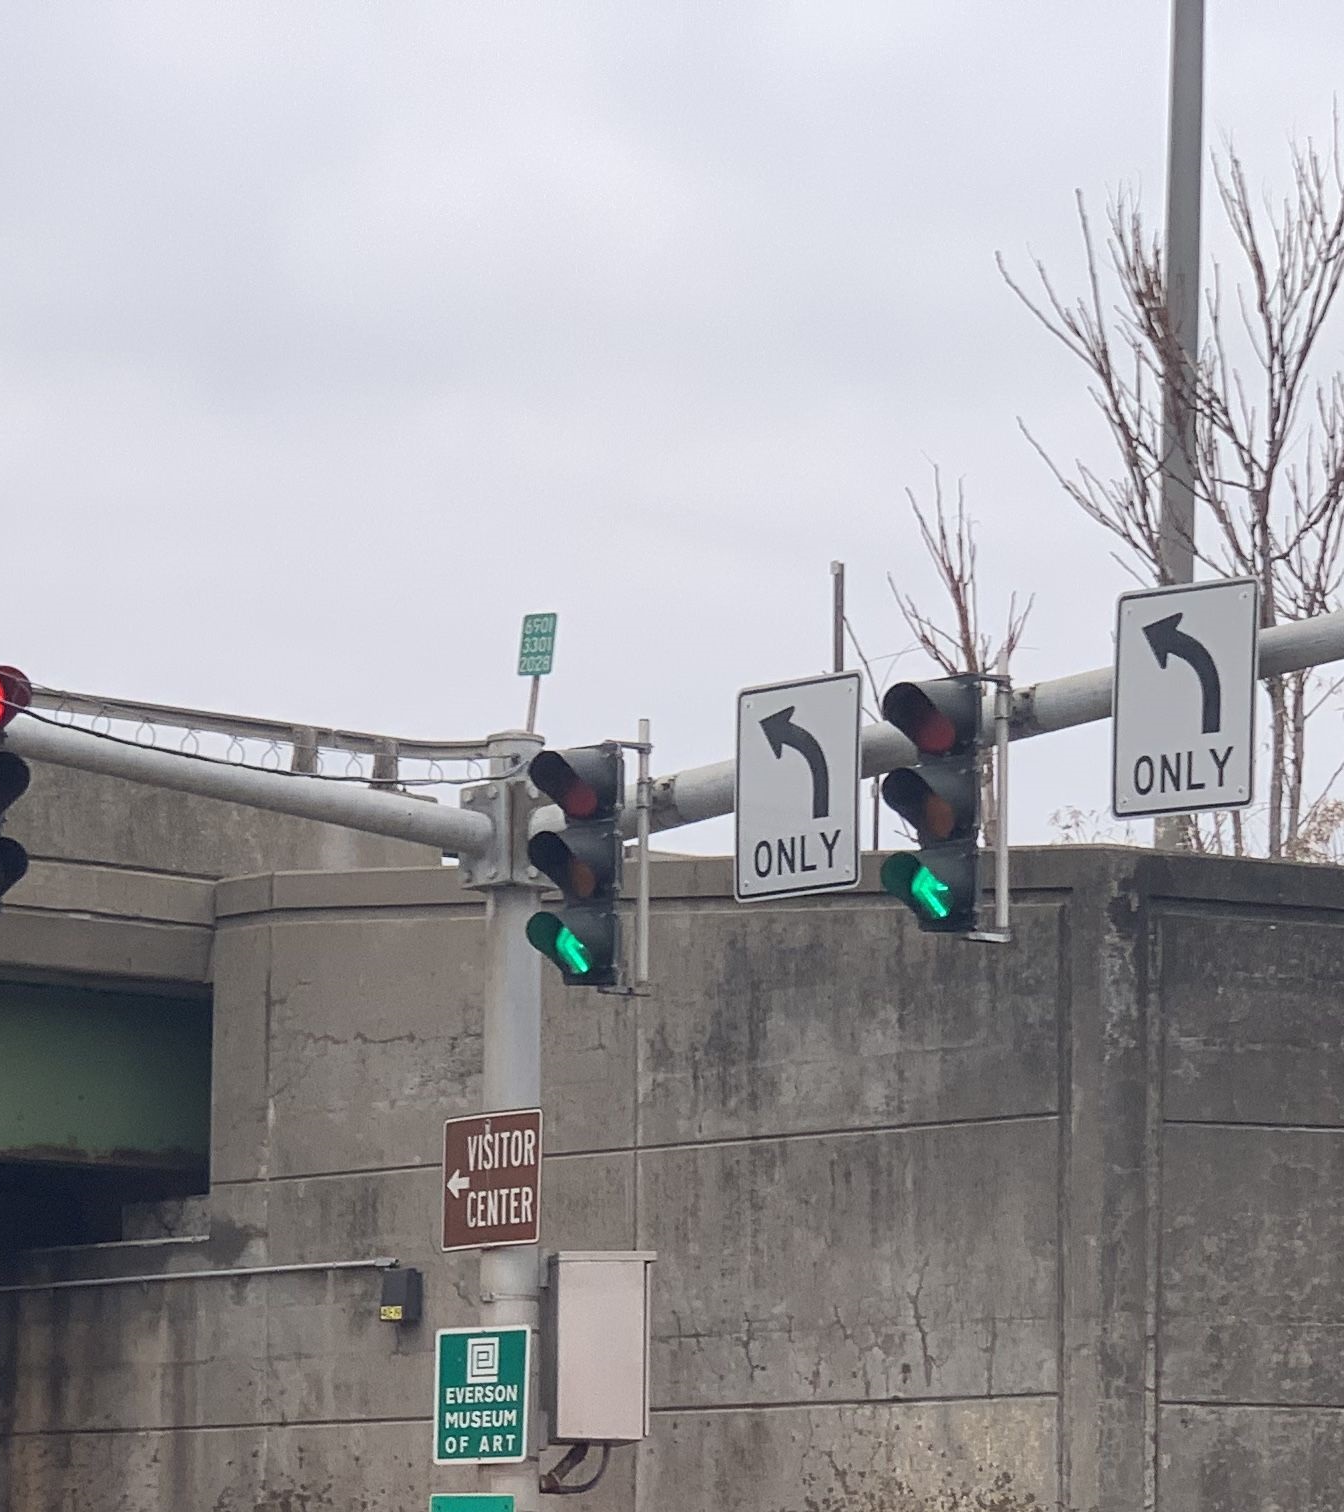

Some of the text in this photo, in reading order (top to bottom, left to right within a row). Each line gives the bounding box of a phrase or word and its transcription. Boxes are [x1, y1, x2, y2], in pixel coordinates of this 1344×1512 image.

[1133, 745, 1234, 796] ONLY
[754, 829, 841, 879] ONLY
[467, 1129, 536, 1172] VISITOR
[466, 1186, 533, 1228] CENTER
[445, 1384, 518, 1404] EVERSON
[445, 1409, 517, 1429] MUSEUM
[445, 1434, 516, 1454] OF ART
